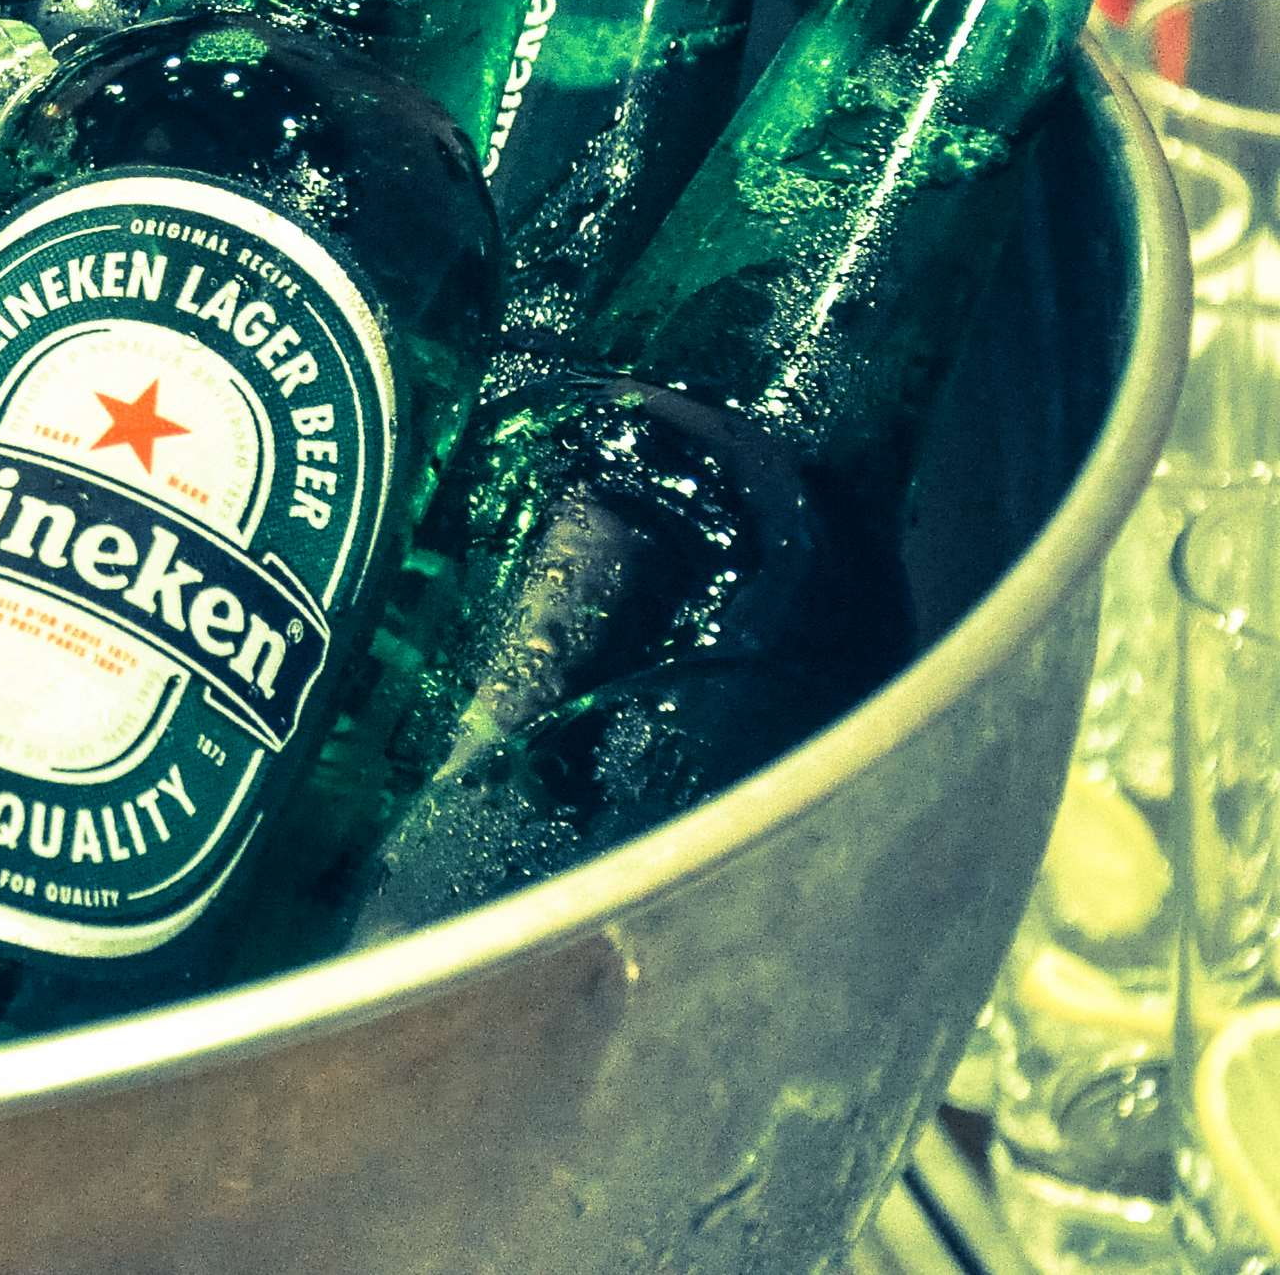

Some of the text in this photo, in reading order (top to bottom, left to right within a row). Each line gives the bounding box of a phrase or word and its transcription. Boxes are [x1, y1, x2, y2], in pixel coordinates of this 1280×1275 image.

[130, 218, 305, 299] ORIGINAL RECIPE
[175, 265, 318, 400] LAGER
[289, 402, 340, 531] BEER
[44, 885, 121, 910] QUALITY
